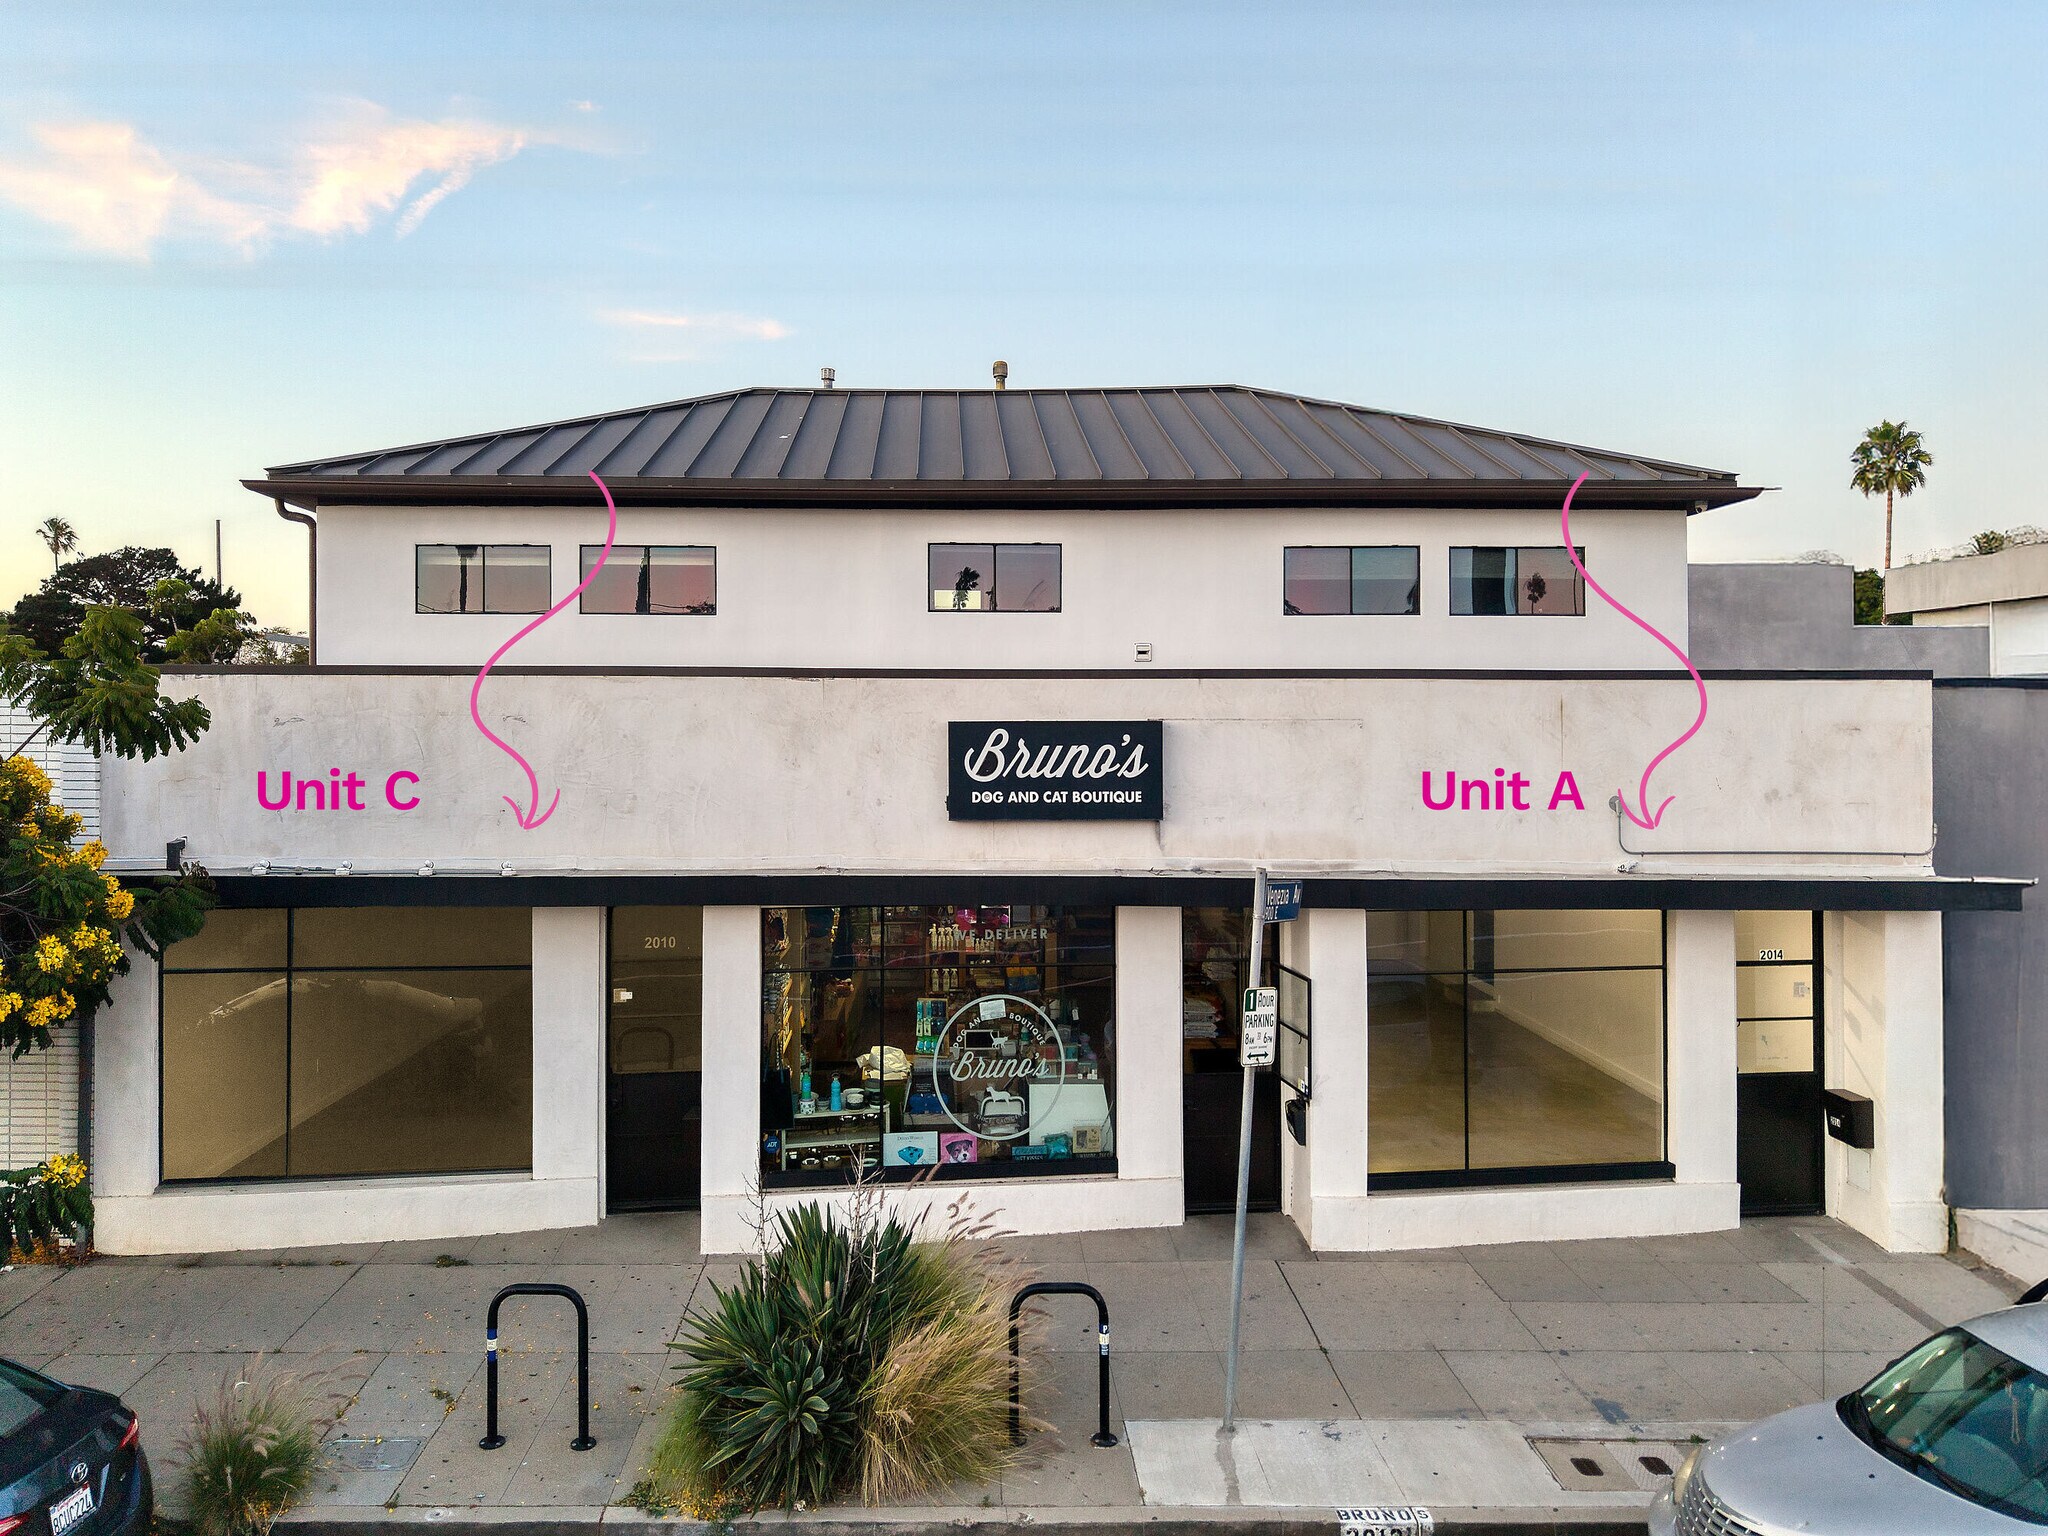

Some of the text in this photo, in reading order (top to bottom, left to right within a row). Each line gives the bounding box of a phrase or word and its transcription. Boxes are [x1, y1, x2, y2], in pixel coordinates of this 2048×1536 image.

[963, 727, 1149, 783] Bruno's
[971, 790, 1143, 804] DOG AND CAT BOUTIQUE
[644, 936, 676, 949] 2010
[984, 928, 1049, 941] DELIVER
[1760, 949, 1784, 961] 2014
[1249, 992, 1254, 1010] 1
[1008, 1011, 1047, 1046] BOUTIQUE
[1245, 1013, 1275, 1029] PARKING
[949, 1051, 1051, 1082] Bruno's
